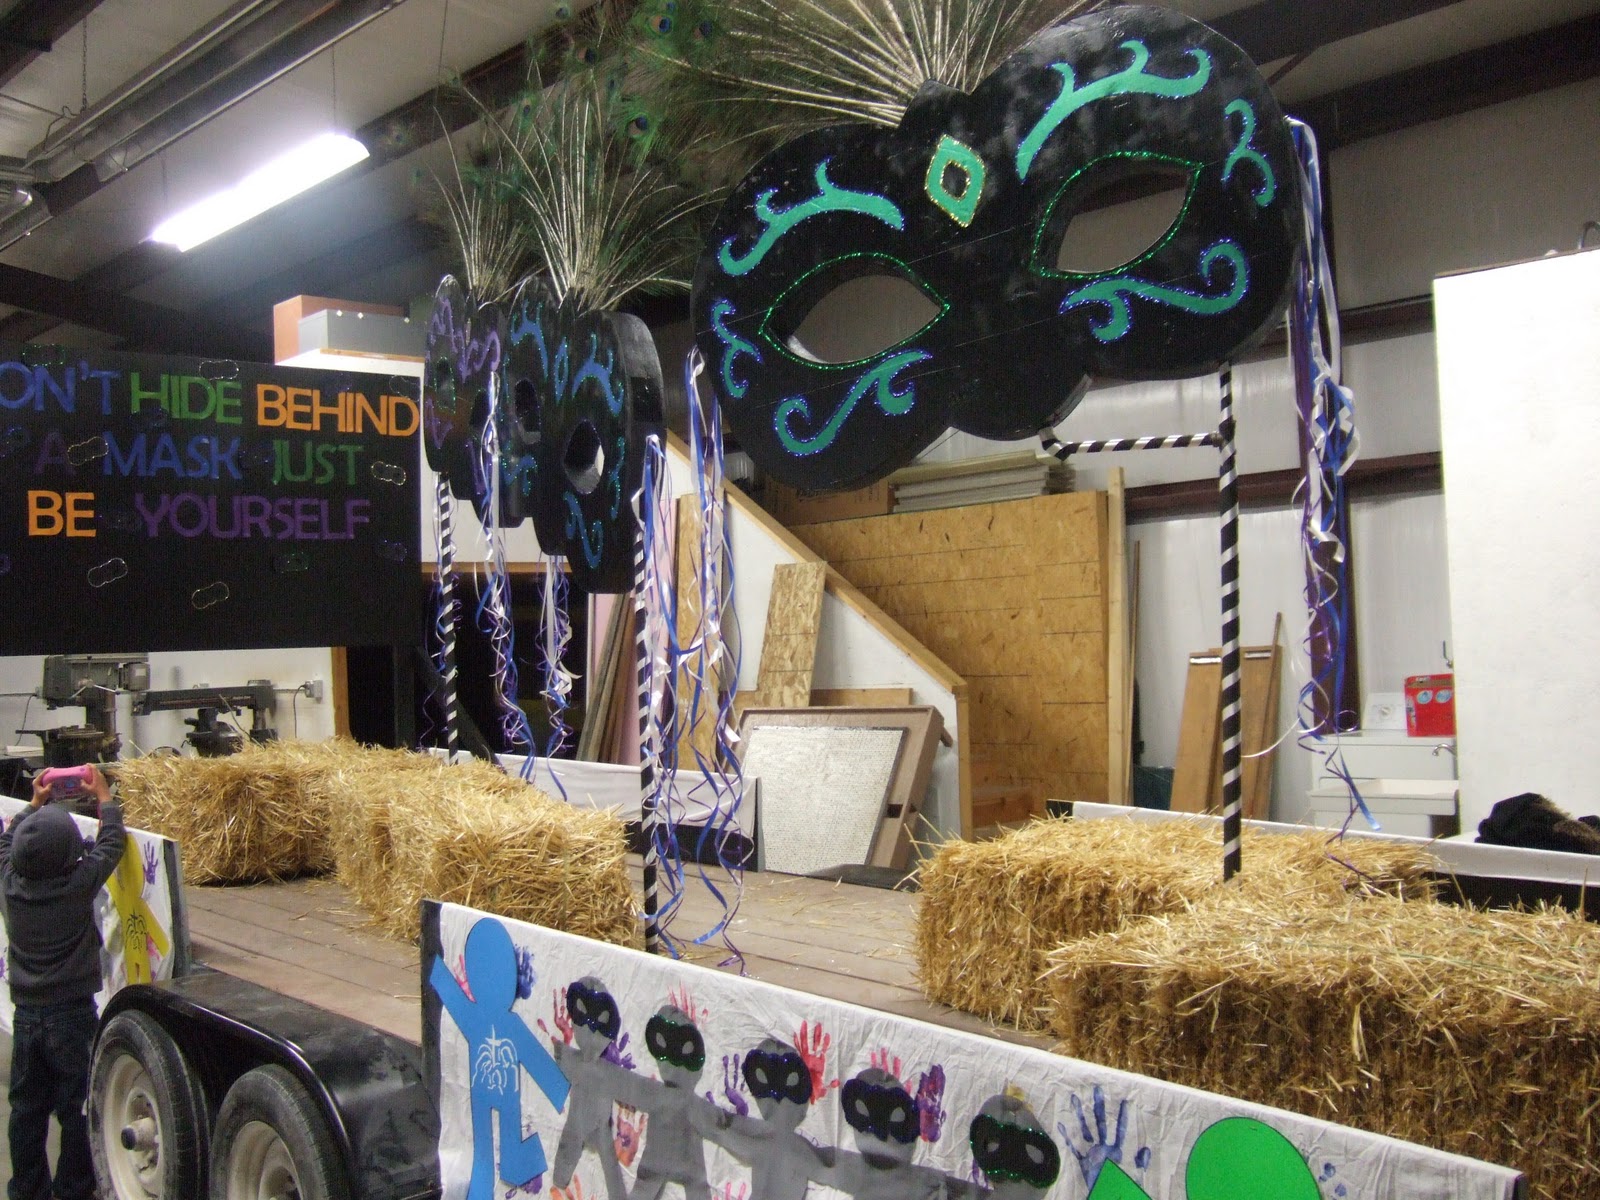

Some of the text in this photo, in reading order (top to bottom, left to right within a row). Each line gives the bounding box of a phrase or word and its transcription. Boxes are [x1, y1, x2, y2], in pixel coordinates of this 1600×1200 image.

[131, 372, 243, 424] HIDE
[257, 383, 420, 437] BEHIND
[34, 431, 364, 485] A MASK JUST
[27, 490, 371, 541] BE YOURSELF
